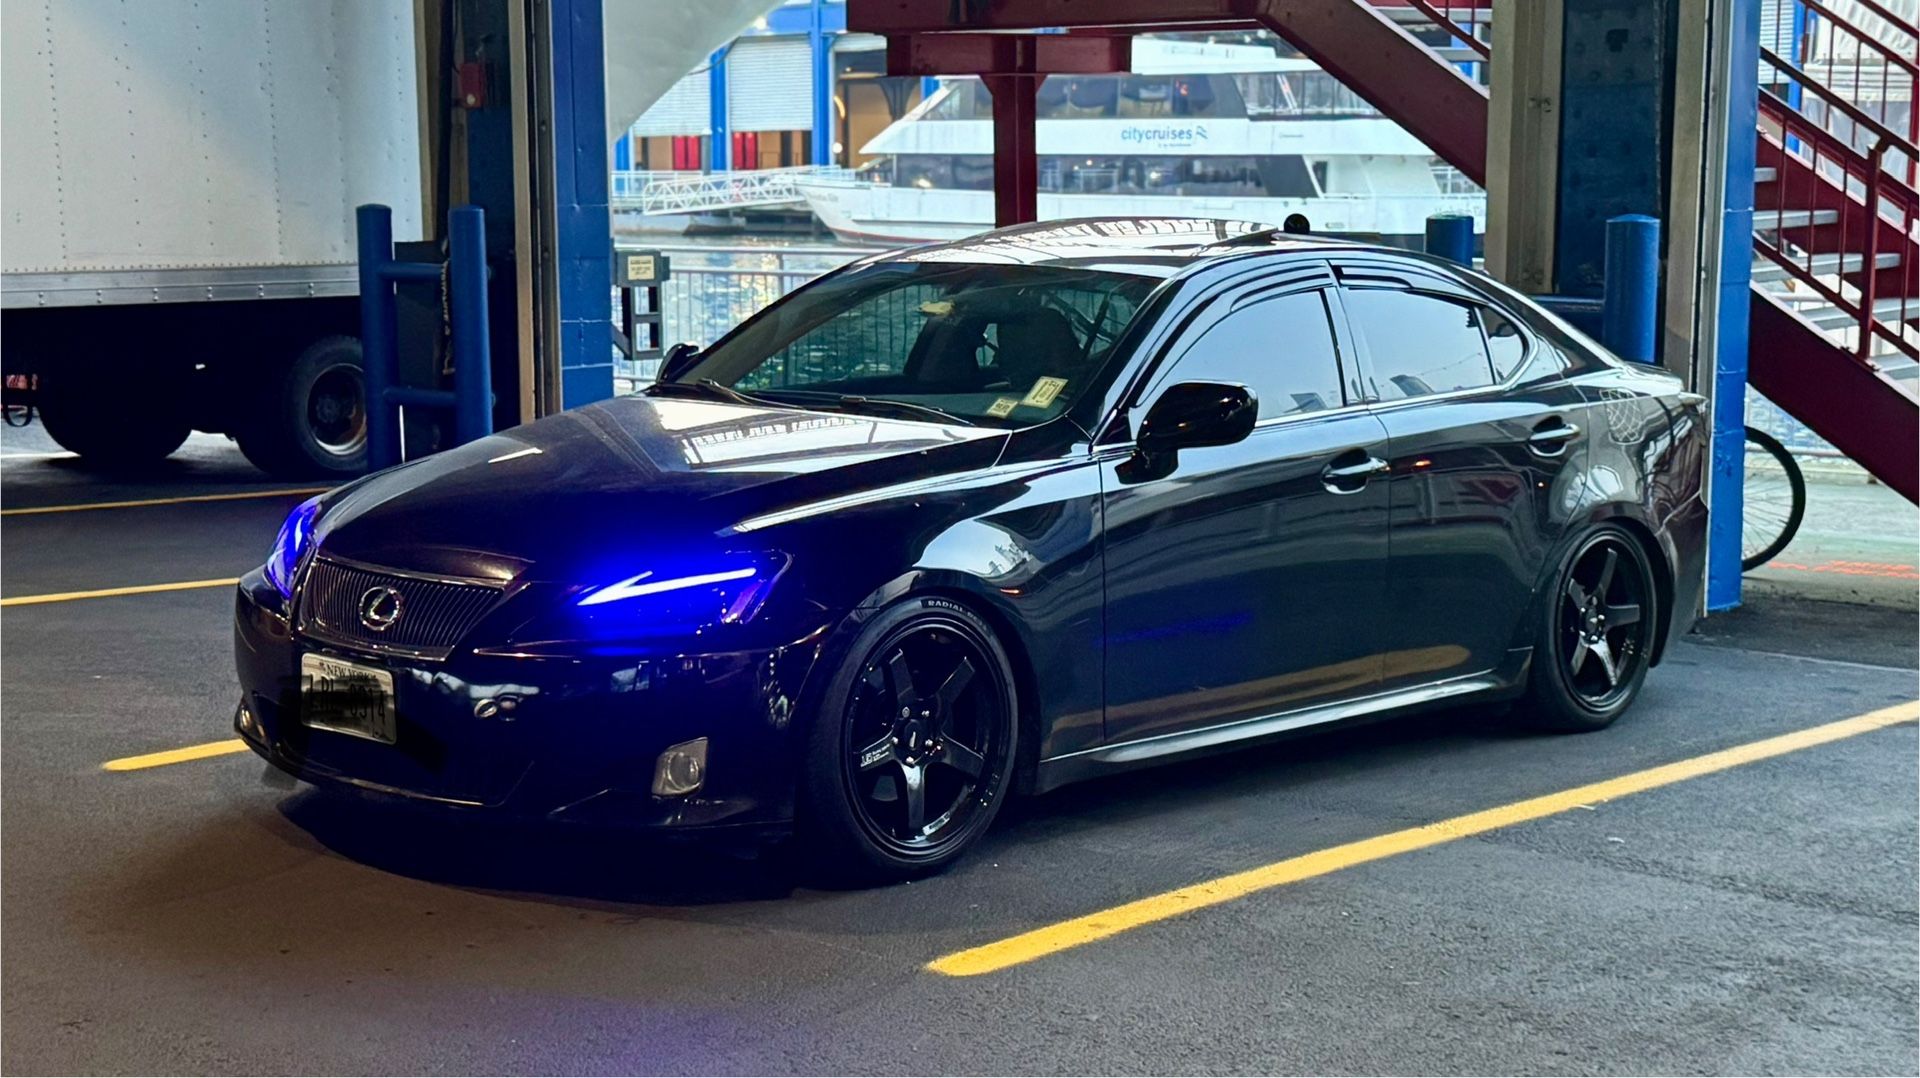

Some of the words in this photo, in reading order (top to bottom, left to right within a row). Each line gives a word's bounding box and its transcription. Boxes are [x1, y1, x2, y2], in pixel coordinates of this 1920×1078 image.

[1121, 126, 1193, 143] citycruises
[928, 600, 963, 612] RADIAL
[326, 663, 347, 678] NEW
